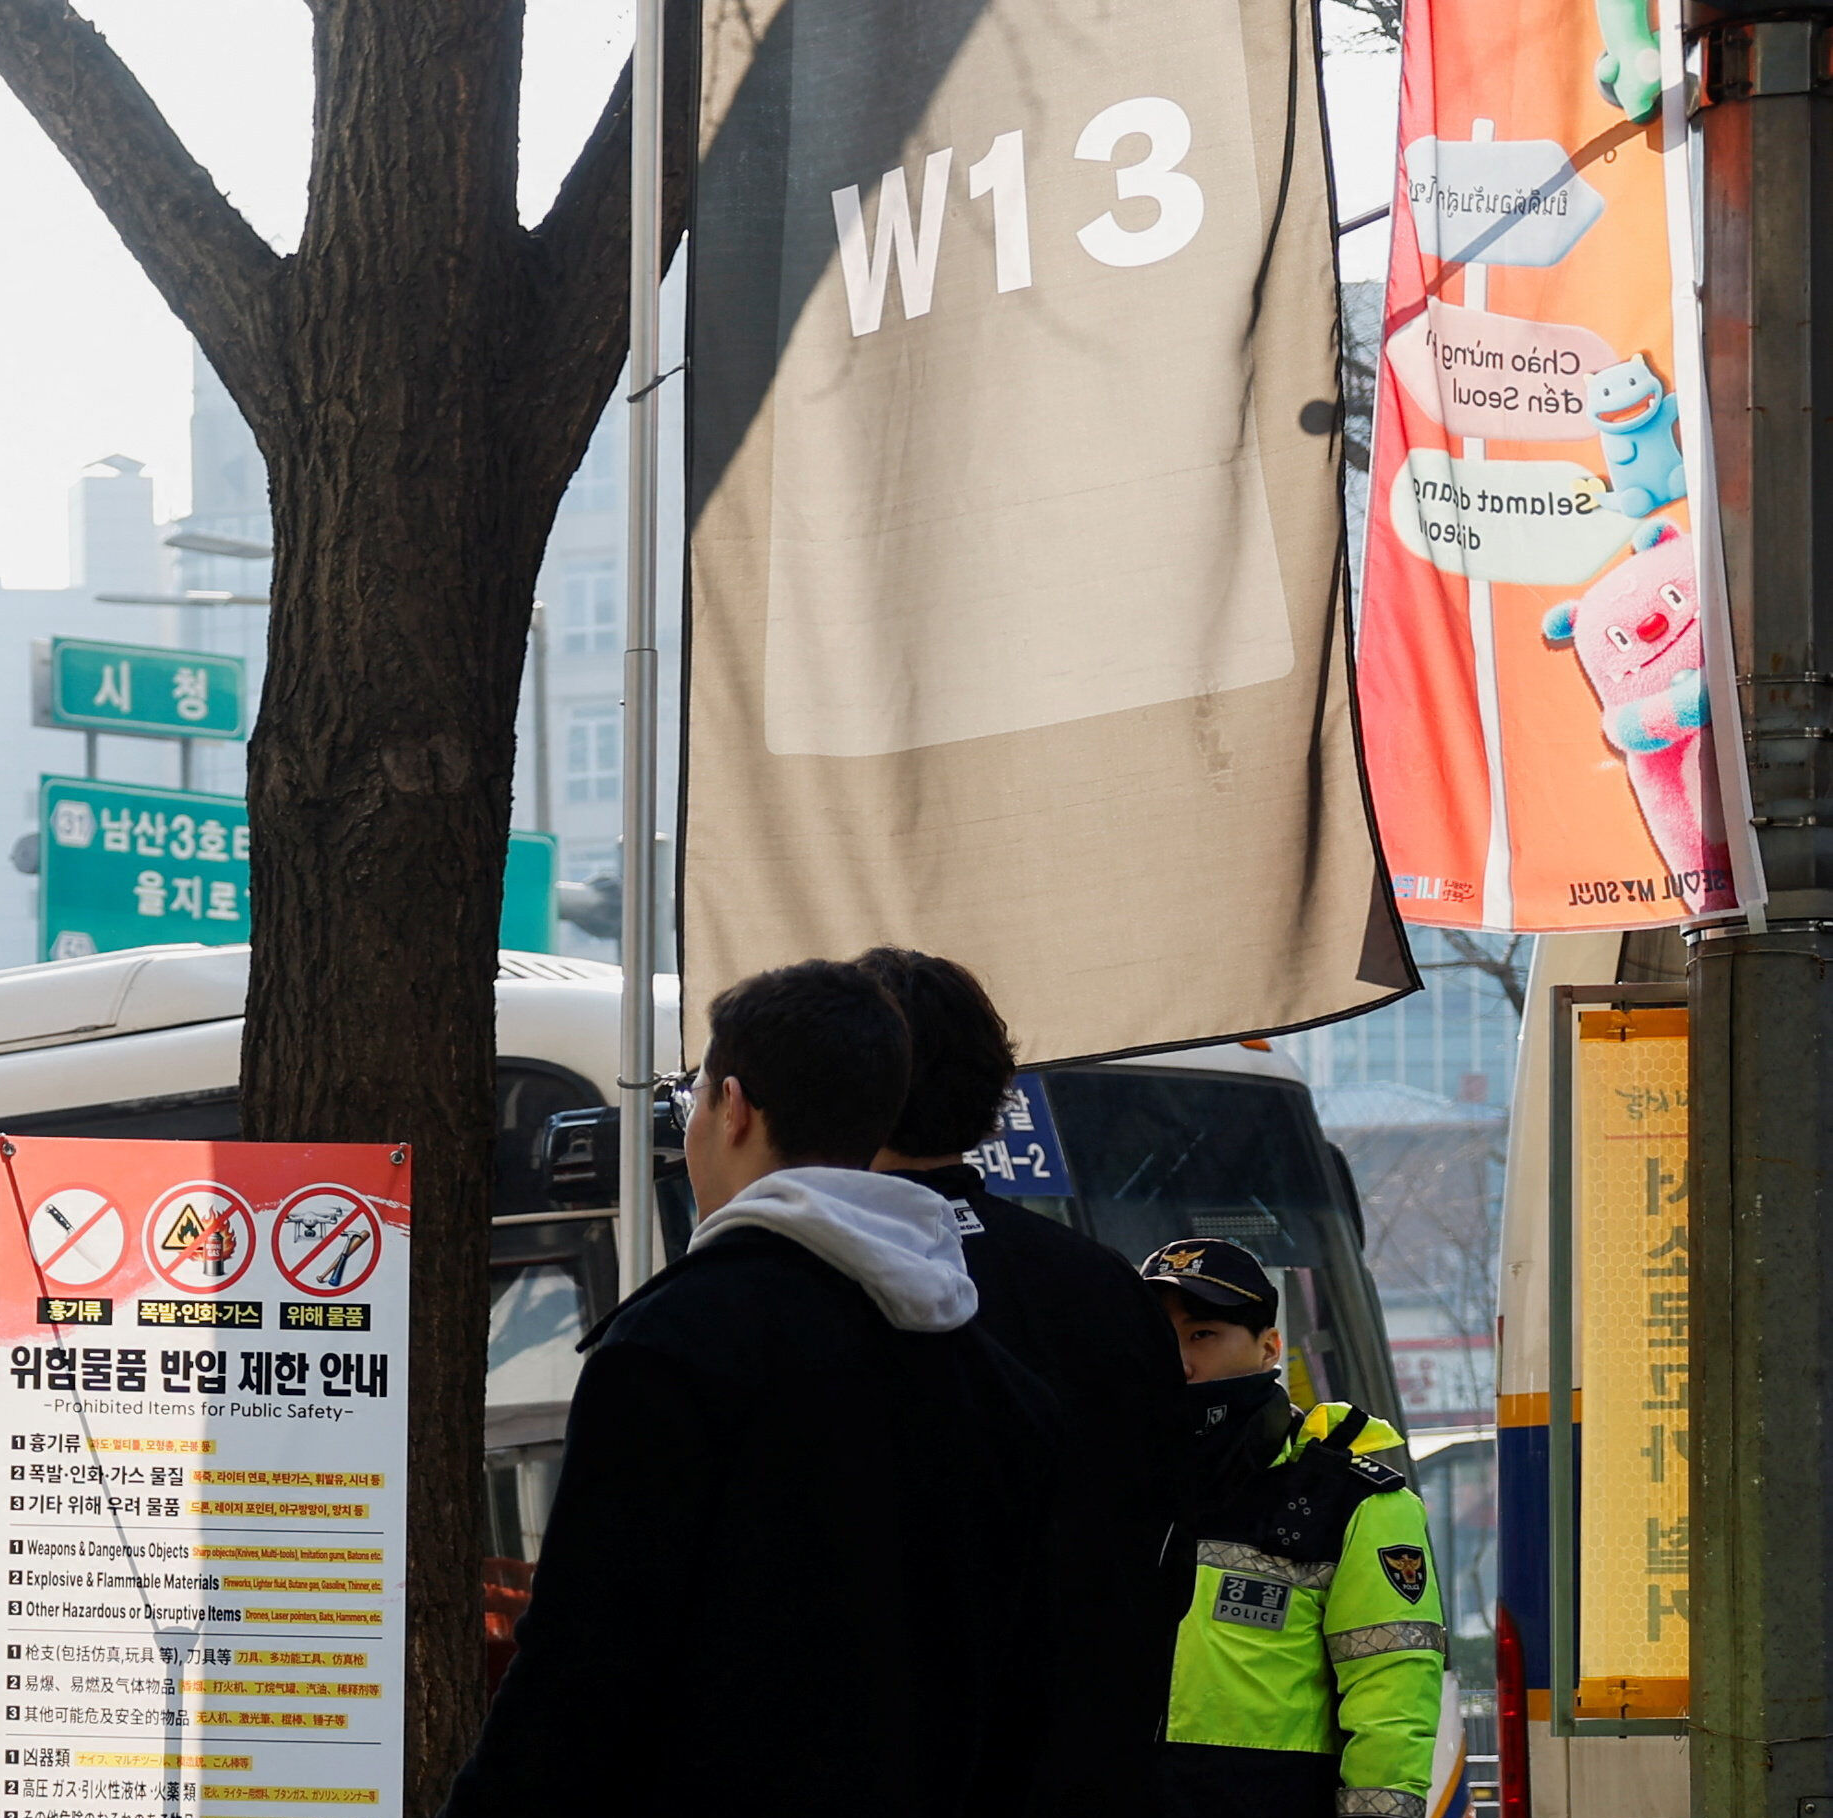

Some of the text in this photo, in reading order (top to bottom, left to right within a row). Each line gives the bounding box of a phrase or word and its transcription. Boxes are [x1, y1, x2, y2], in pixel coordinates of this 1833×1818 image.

[831, 96, 1205, 338] W13
[133, 869, 250, 921] 을지로
[47, 1299, 102, 1322] 흉기류
[287, 1305, 363, 1327] 위해 물품
[10, 1346, 388, 1398] 위험물품 반입 제한 안내
[149, 1401, 282, 1418] Items for Public
[29, 1433, 81, 1453] 흉기류
[29, 1464, 183, 1486] 폭발·인화·가스 물질
[29, 1495, 180, 1516] 기타 위해 우려 물품
[27, 1540, 189, 1563] Weapons & Dangerous Objects
[27, 1571, 219, 1590] Explosive & Flammable Materials
[1226, 1578, 1283, 1609] 경찰
[26, 1601, 241, 1624] Other Hazardous or Disruptive Items
[1220, 1604, 1278, 1624] POLICE
[25, 1706, 189, 1727] 其他可能危及安全的物品
[24, 1748, 70, 1767] 凶器類
